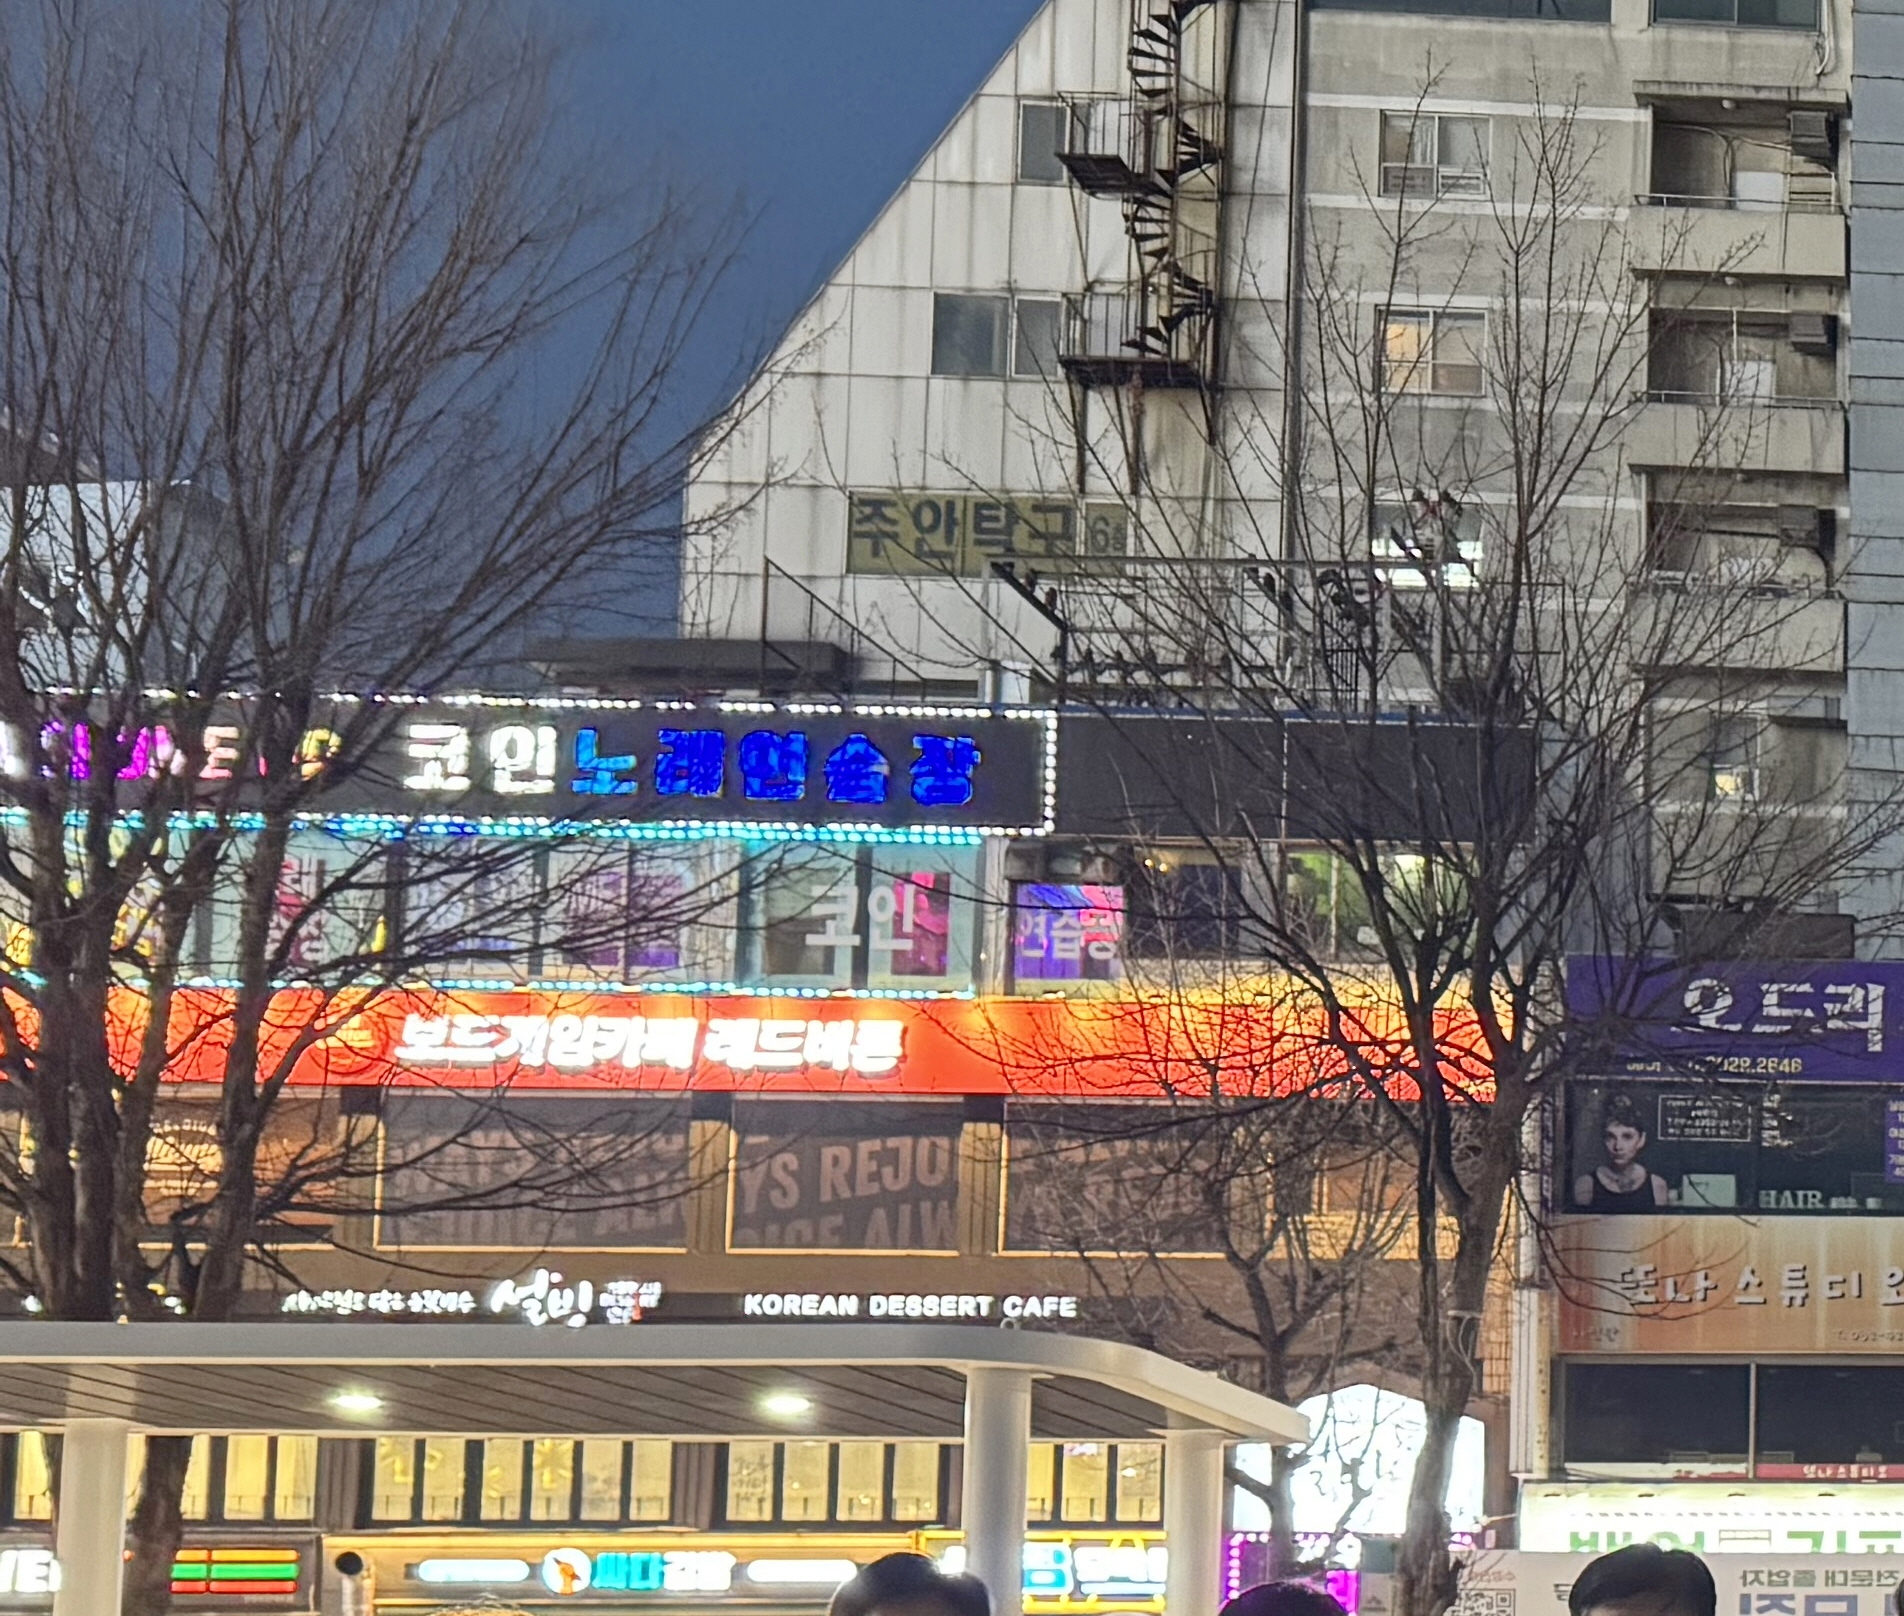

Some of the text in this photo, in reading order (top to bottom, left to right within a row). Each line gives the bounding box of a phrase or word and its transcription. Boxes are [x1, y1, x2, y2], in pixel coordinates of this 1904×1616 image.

[805, 885, 916, 951] 코인
[1758, 1189, 1823, 1210] HAIR
[742, 1292, 1078, 1319] KOREAN DESSERT CAFE
